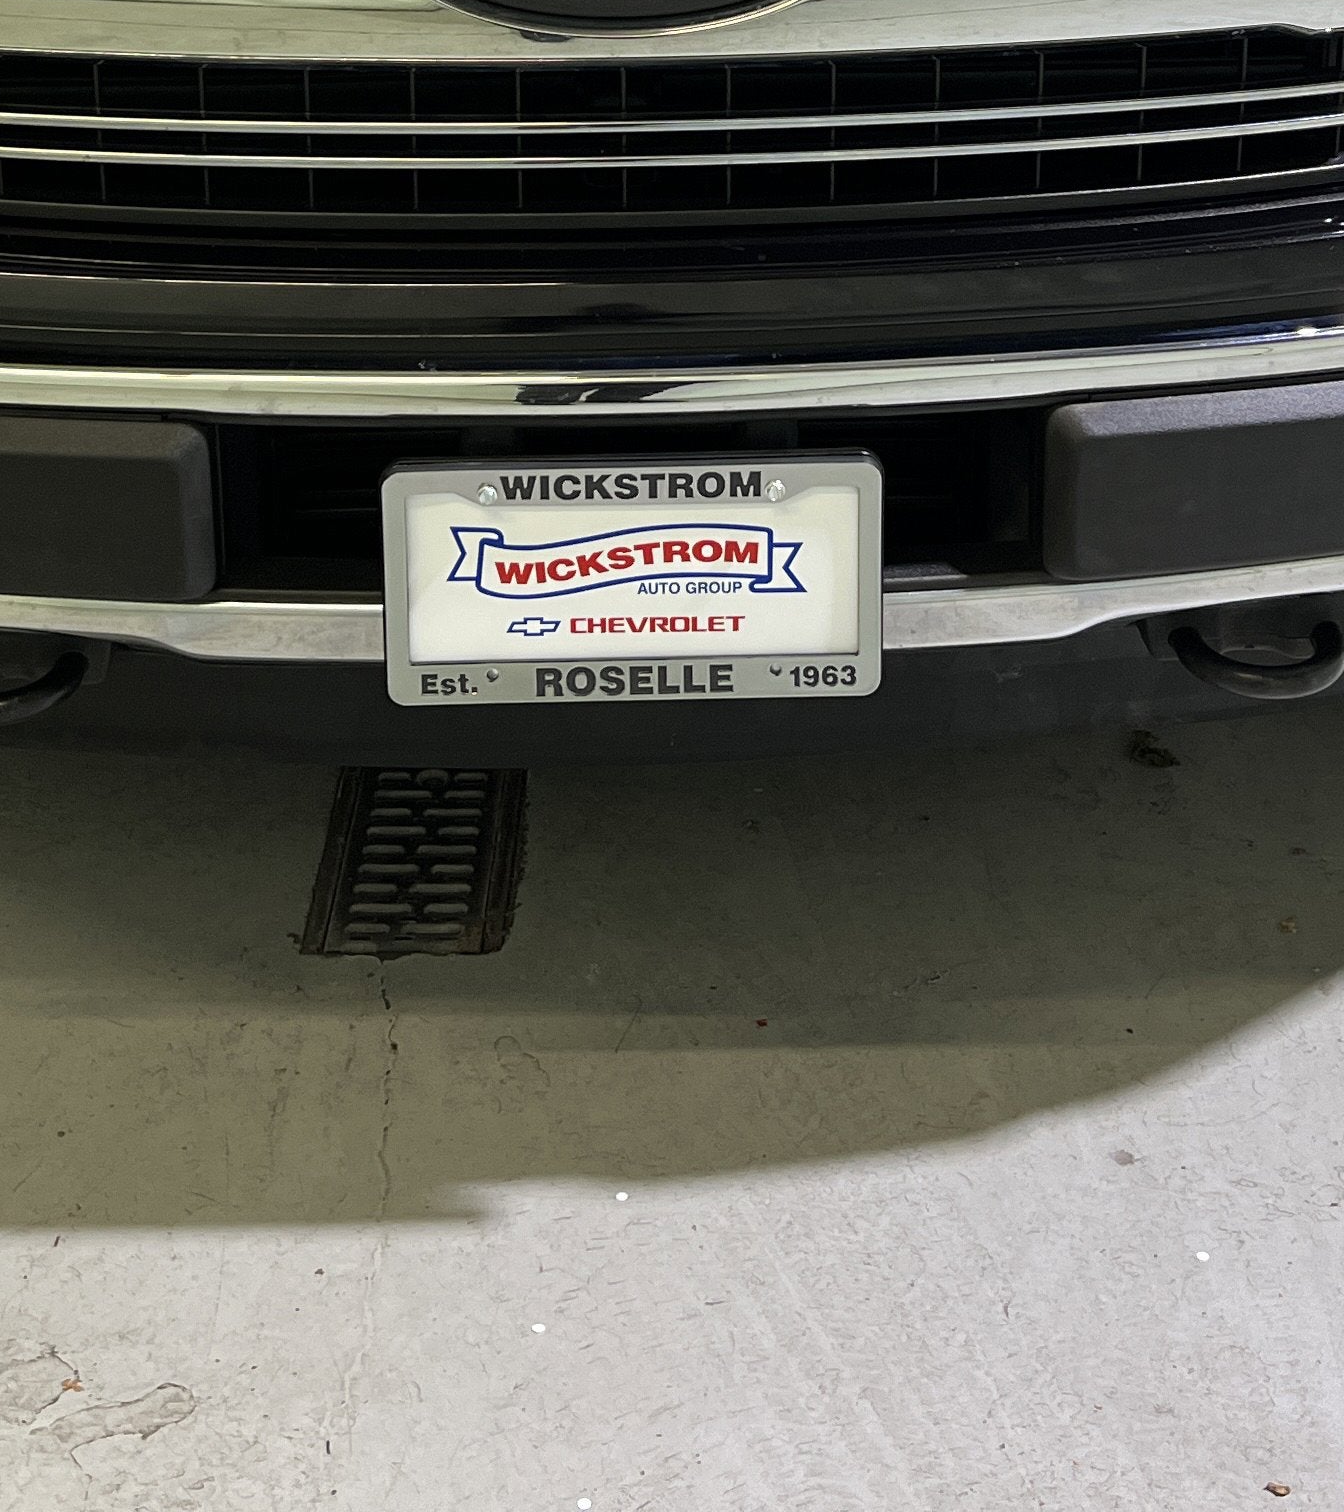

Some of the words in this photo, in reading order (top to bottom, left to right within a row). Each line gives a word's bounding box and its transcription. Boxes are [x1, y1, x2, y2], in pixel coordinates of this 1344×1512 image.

[500, 471, 762, 501] WICKSTROM
[494, 540, 759, 585] WICKSTROM
[637, 581, 681, 596] AUTO
[685, 581, 743, 595] GROUP
[570, 616, 745, 634] CHEVROLET
[421, 673, 478, 696] Est.
[535, 664, 734, 698] ROSELLE
[788, 666, 857, 688] 1963
